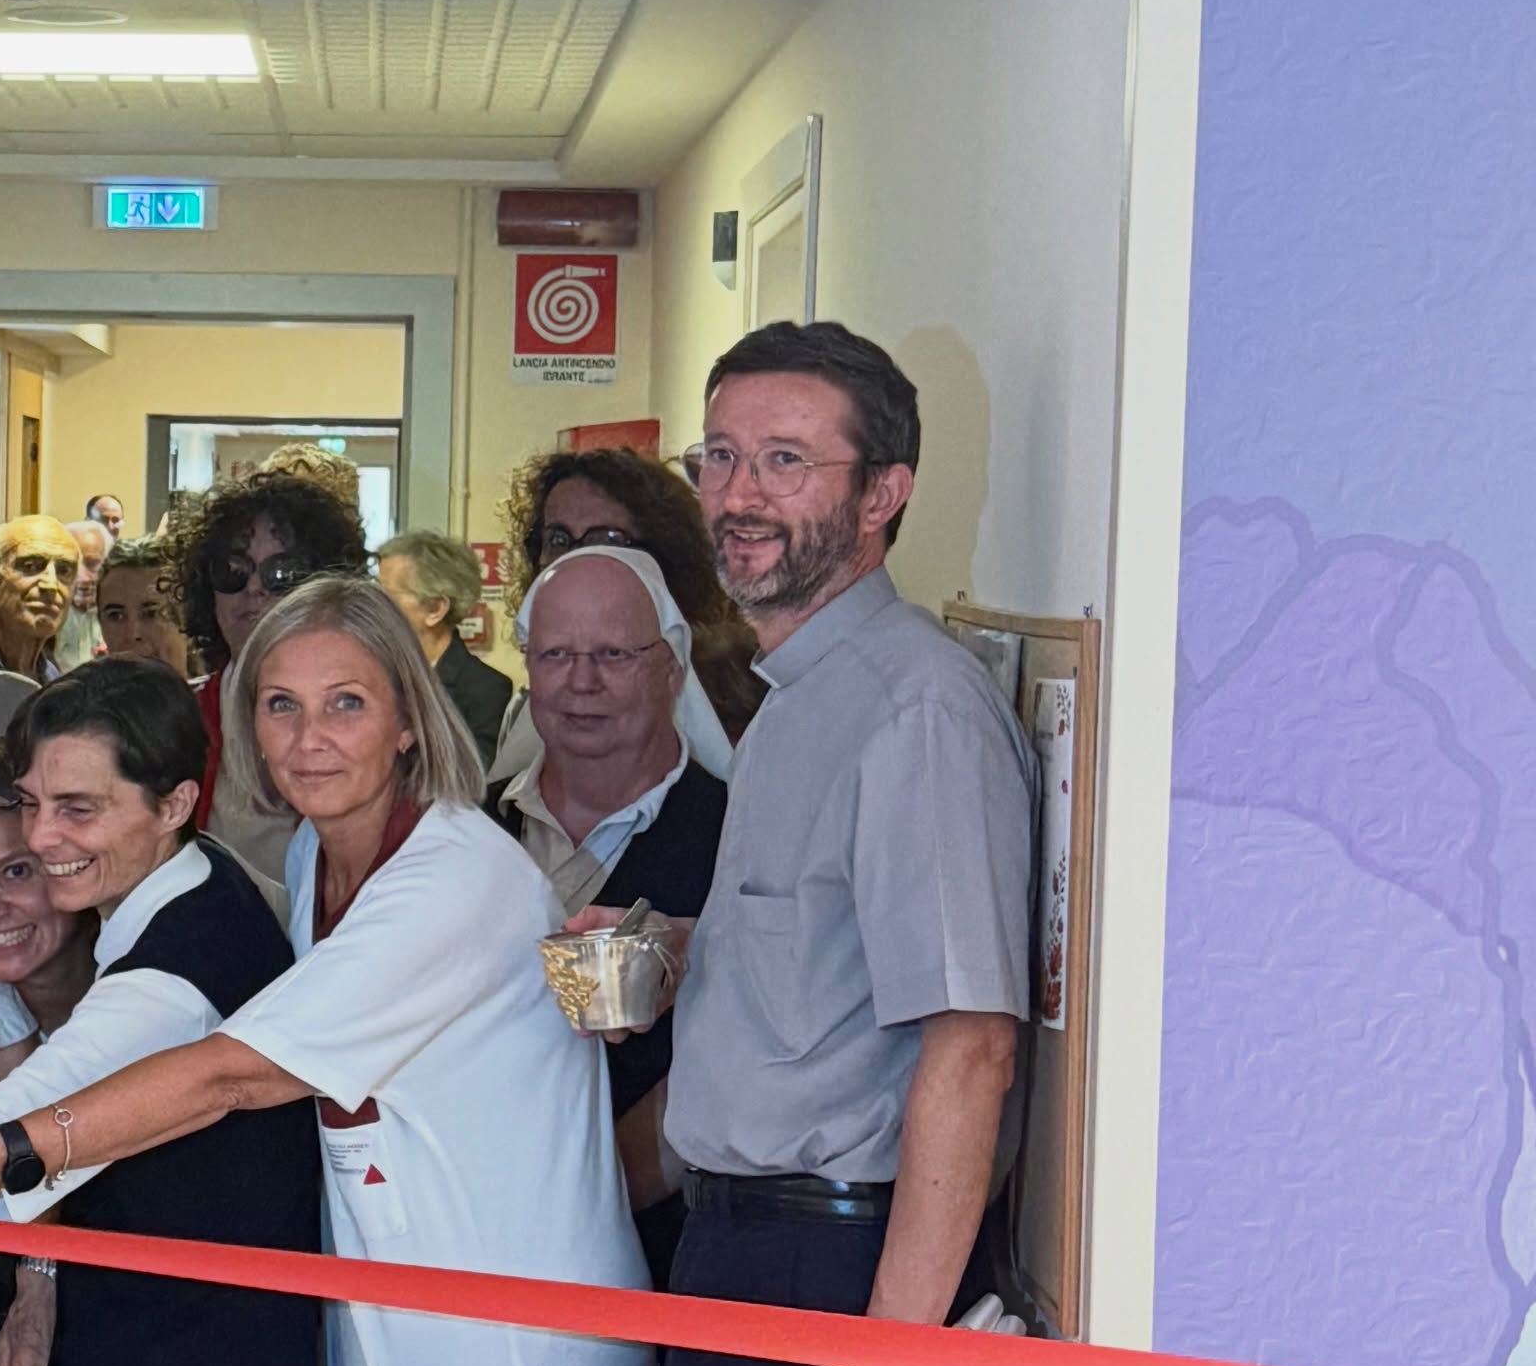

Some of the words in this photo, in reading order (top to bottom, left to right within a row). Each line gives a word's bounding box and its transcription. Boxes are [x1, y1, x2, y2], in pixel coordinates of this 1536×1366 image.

[512, 357, 549, 369] LANCIA
[550, 357, 617, 370] ANTINCENDIO
[542, 371, 586, 383] IDRANTE
